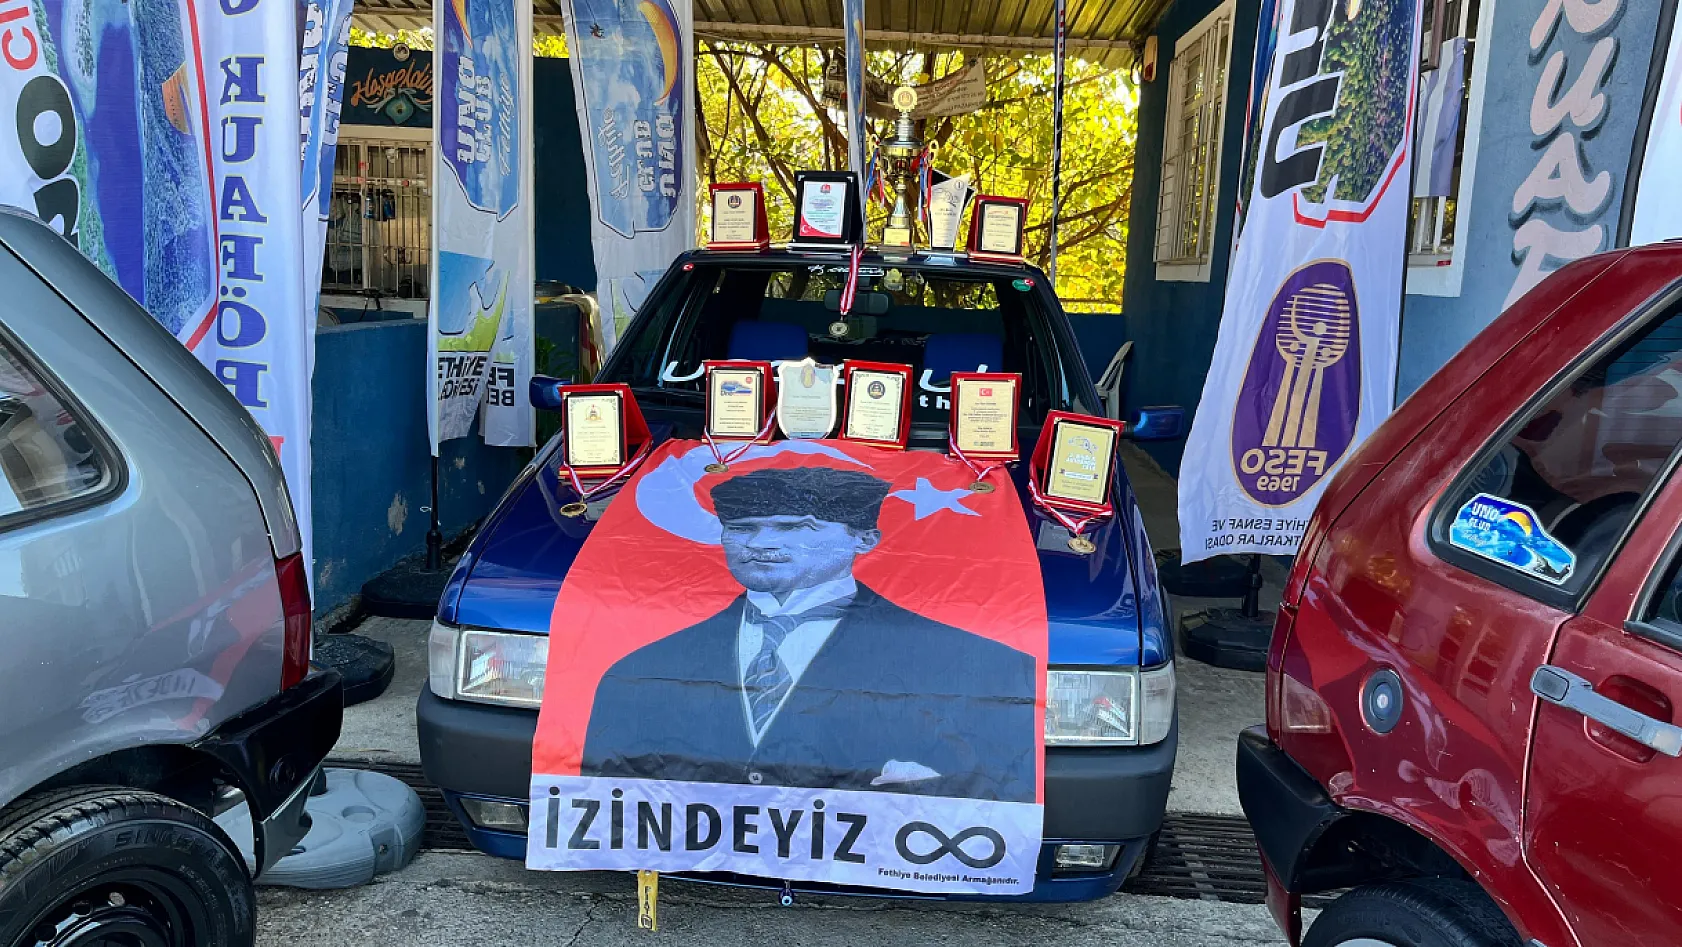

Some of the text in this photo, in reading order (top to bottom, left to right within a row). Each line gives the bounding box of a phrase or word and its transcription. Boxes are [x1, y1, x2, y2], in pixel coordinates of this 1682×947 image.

[456, 55, 475, 163] UNO
[475, 75, 492, 162] CLUB
[545, 785, 868, 865] İZİNDEYİZ
[877, 867, 911, 880] Fethiye
[913, 872, 959, 883] Belediyesi
